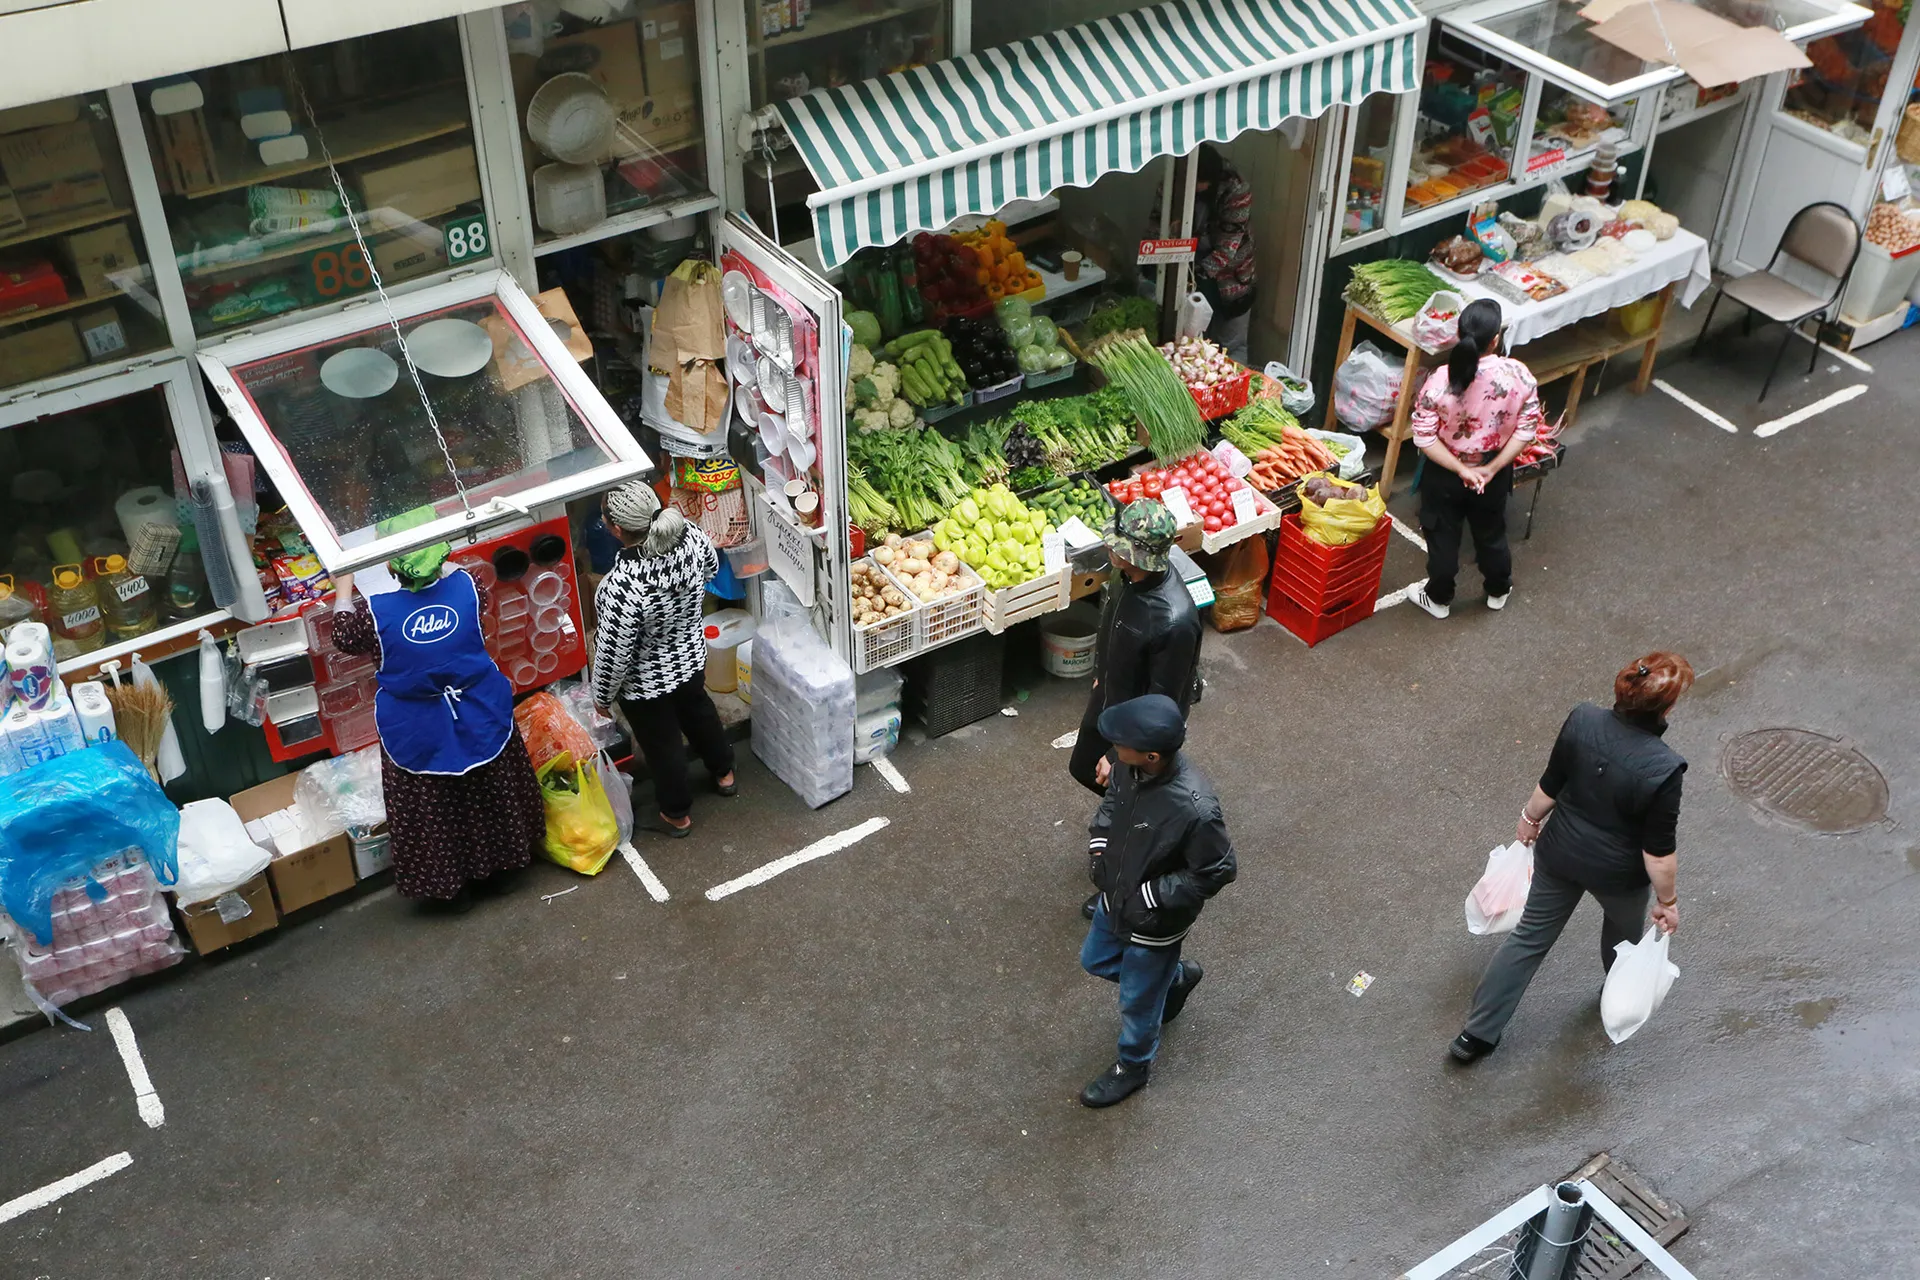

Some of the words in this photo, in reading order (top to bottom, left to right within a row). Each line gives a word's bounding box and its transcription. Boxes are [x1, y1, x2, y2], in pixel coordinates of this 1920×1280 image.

[449, 222, 487, 258] 88
[312, 243, 372, 296] 88
[119, 577, 147, 598] 4400
[66, 607, 97, 625] 4000
[410, 610, 452, 638] Adal
